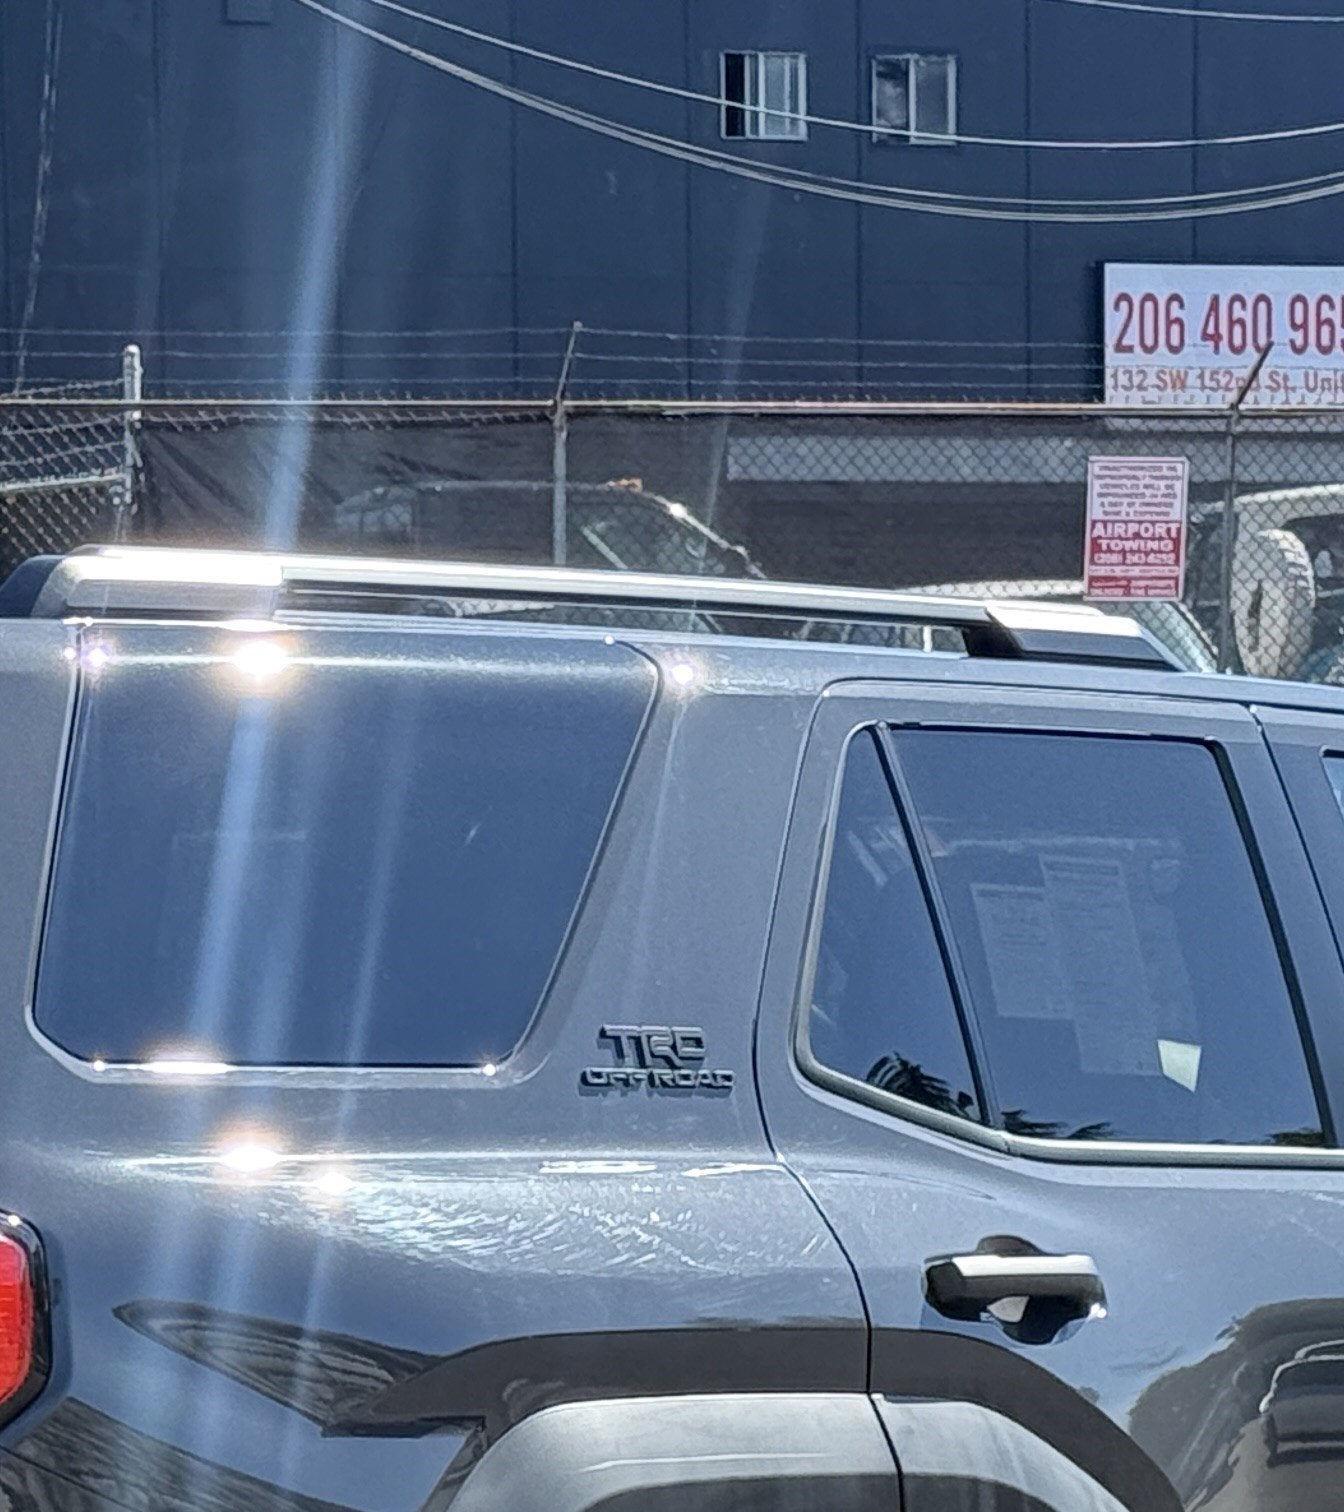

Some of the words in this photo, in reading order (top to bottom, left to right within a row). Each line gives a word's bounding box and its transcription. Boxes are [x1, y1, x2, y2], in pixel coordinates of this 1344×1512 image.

[1112, 291, 1186, 355] 206
[1200, 293, 1273, 356] 460
[1109, 369, 1149, 393] 132
[1156, 369, 1189, 393] SW
[1090, 521, 1181, 539] AIRPORT
[1096, 539, 1174, 552] TOWING
[598, 1024, 706, 1069] TRD
